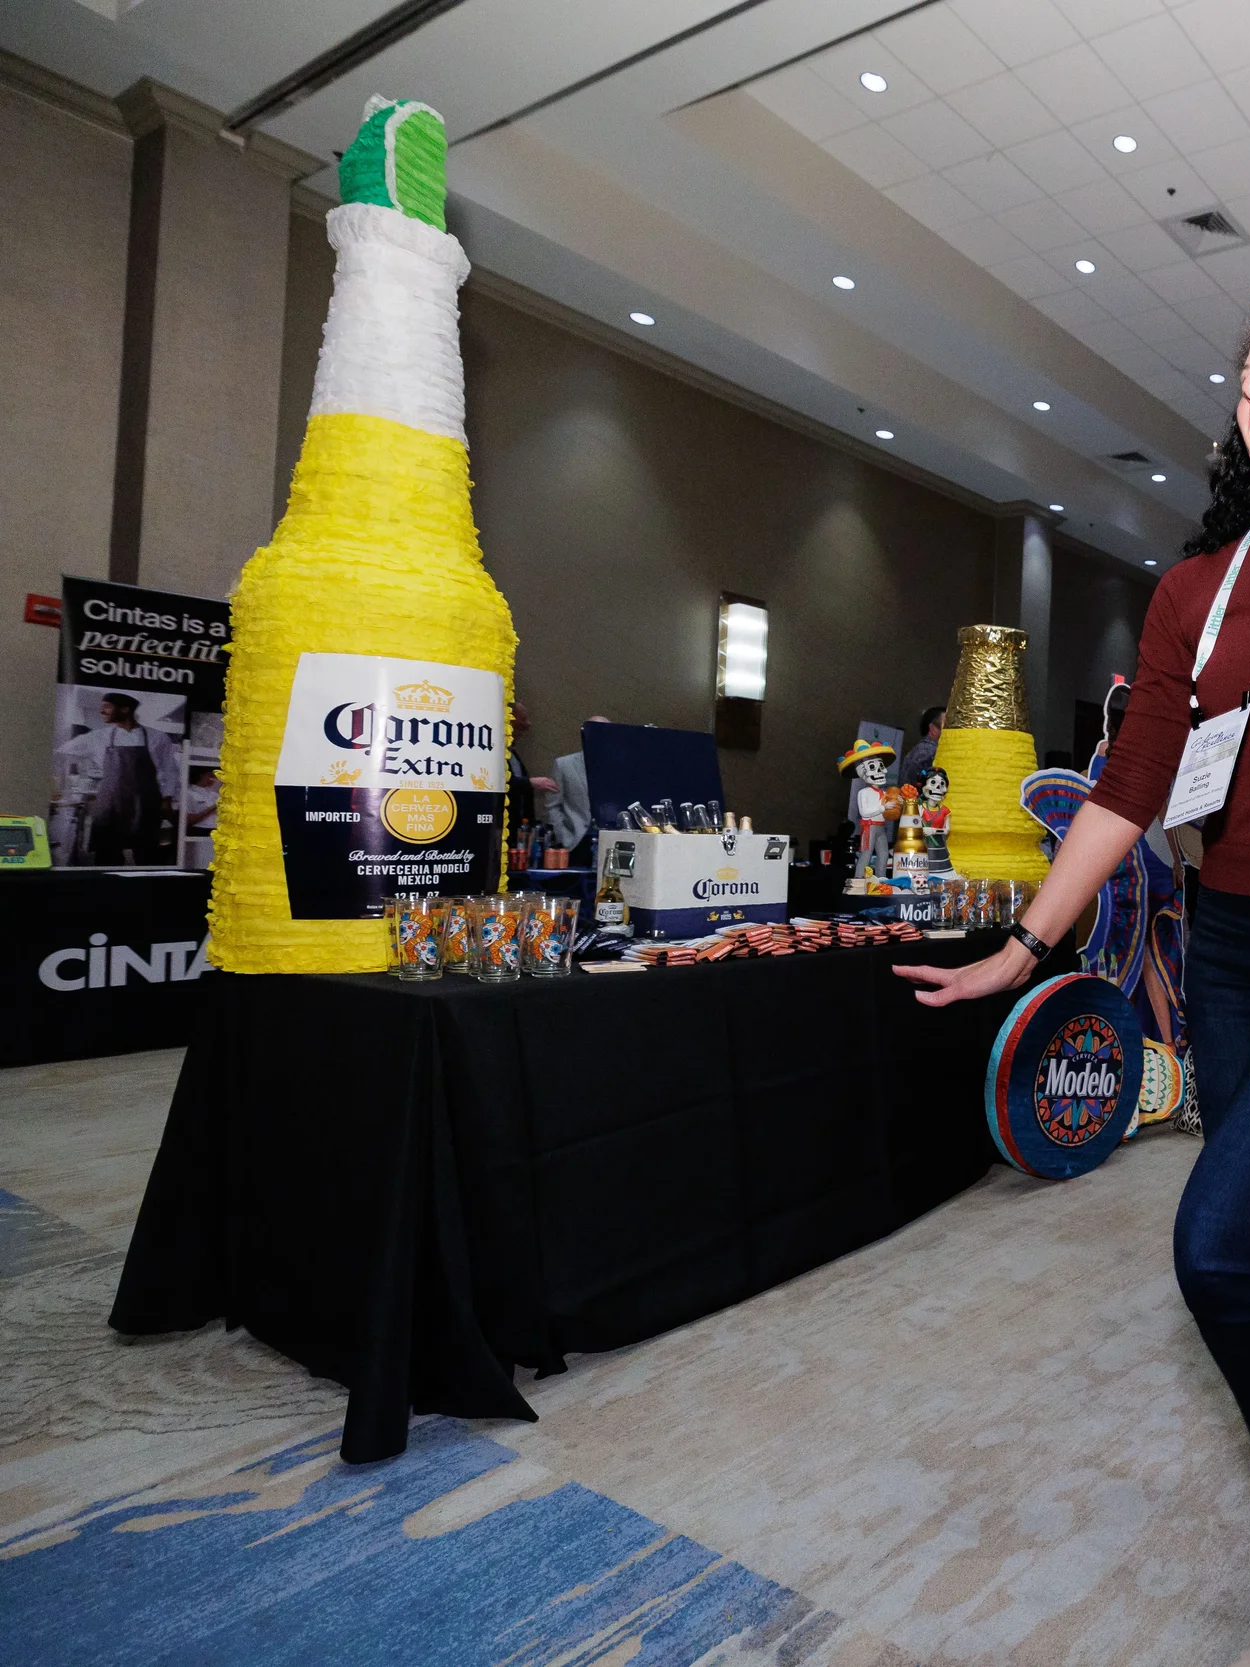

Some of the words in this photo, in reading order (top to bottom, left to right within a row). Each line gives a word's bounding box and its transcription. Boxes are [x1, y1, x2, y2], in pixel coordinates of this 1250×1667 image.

[83, 599, 178, 631] Cintas
[182, 613, 205, 634] is
[208, 621, 227, 638] a
[1206, 604, 1226, 637] Littler
[79, 630, 186, 657] perfect
[187, 640, 220, 662] fit
[79, 656, 195, 685] solution
[323, 701, 494, 756] Corona
[379, 746, 465, 778] Extra
[399, 780, 424, 788] SINCE
[1193, 772, 1211, 784] Suzie
[413, 794, 430, 803] LA
[391, 803, 449, 813] CERVEZA
[305, 811, 361, 823] IMPORTED
[407, 813, 435, 822] MAS
[477, 814, 493, 824] BEER
[406, 823, 435, 832] FINA
[348, 850, 401, 862] Brewed
[400, 851, 424, 861] and
[424, 850, 463, 861] Bottled
[357, 864, 430, 875] CERVECERIA
[433, 863, 470, 874] MODELO
[397, 874, 440, 886] MEXICO
[692, 878, 760, 902] Corona
[1071, 1053, 1098, 1064] CERVEZA
[1044, 1058, 1116, 1098] Modelo
